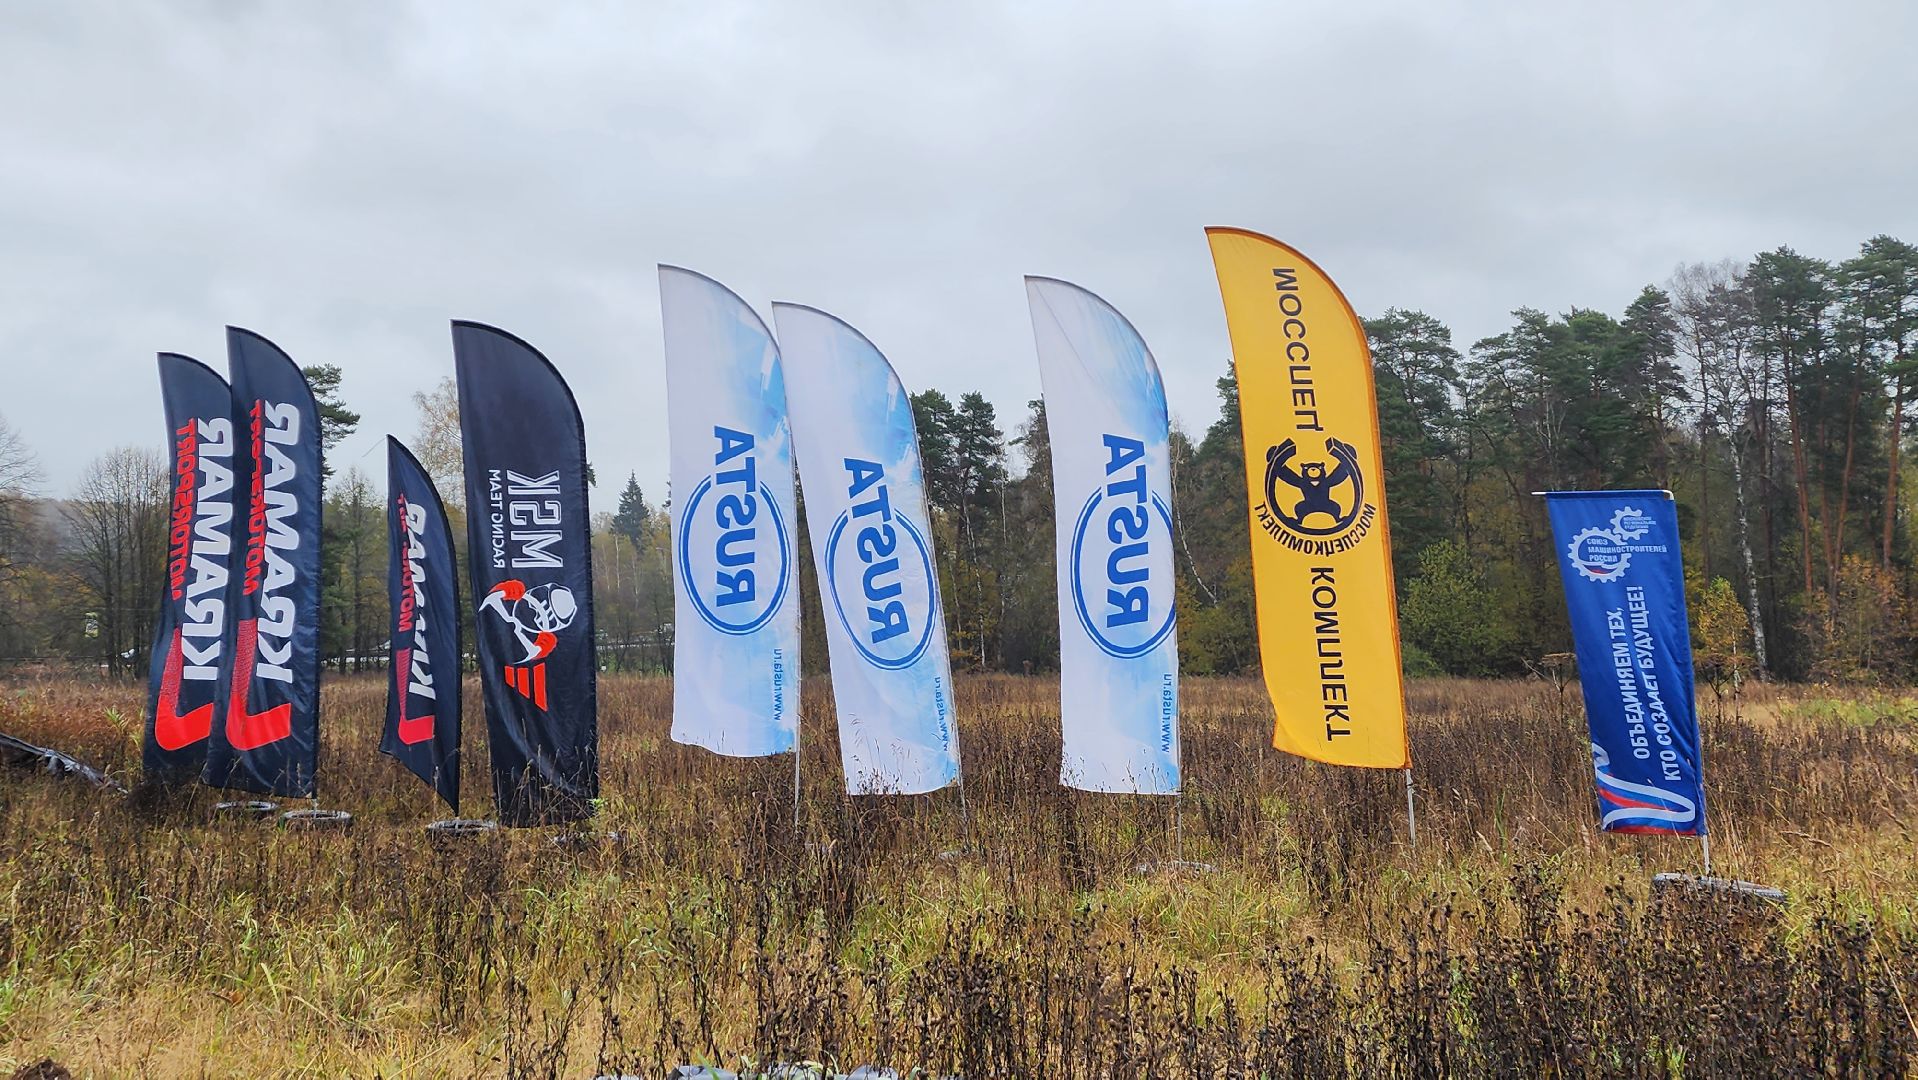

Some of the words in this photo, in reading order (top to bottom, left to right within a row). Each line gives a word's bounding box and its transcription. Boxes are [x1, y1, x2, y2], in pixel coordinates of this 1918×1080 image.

[1606, 607, 1627, 639] ТЕХ,
[1626, 586, 1655, 669] БУДУЩЕЕ!
[1613, 642, 1651, 759] ОБЪЕДИНЯЕМ
[1642, 671, 1672, 746] СОЗДАЕТ
[1660, 750, 1681, 781] КТО
